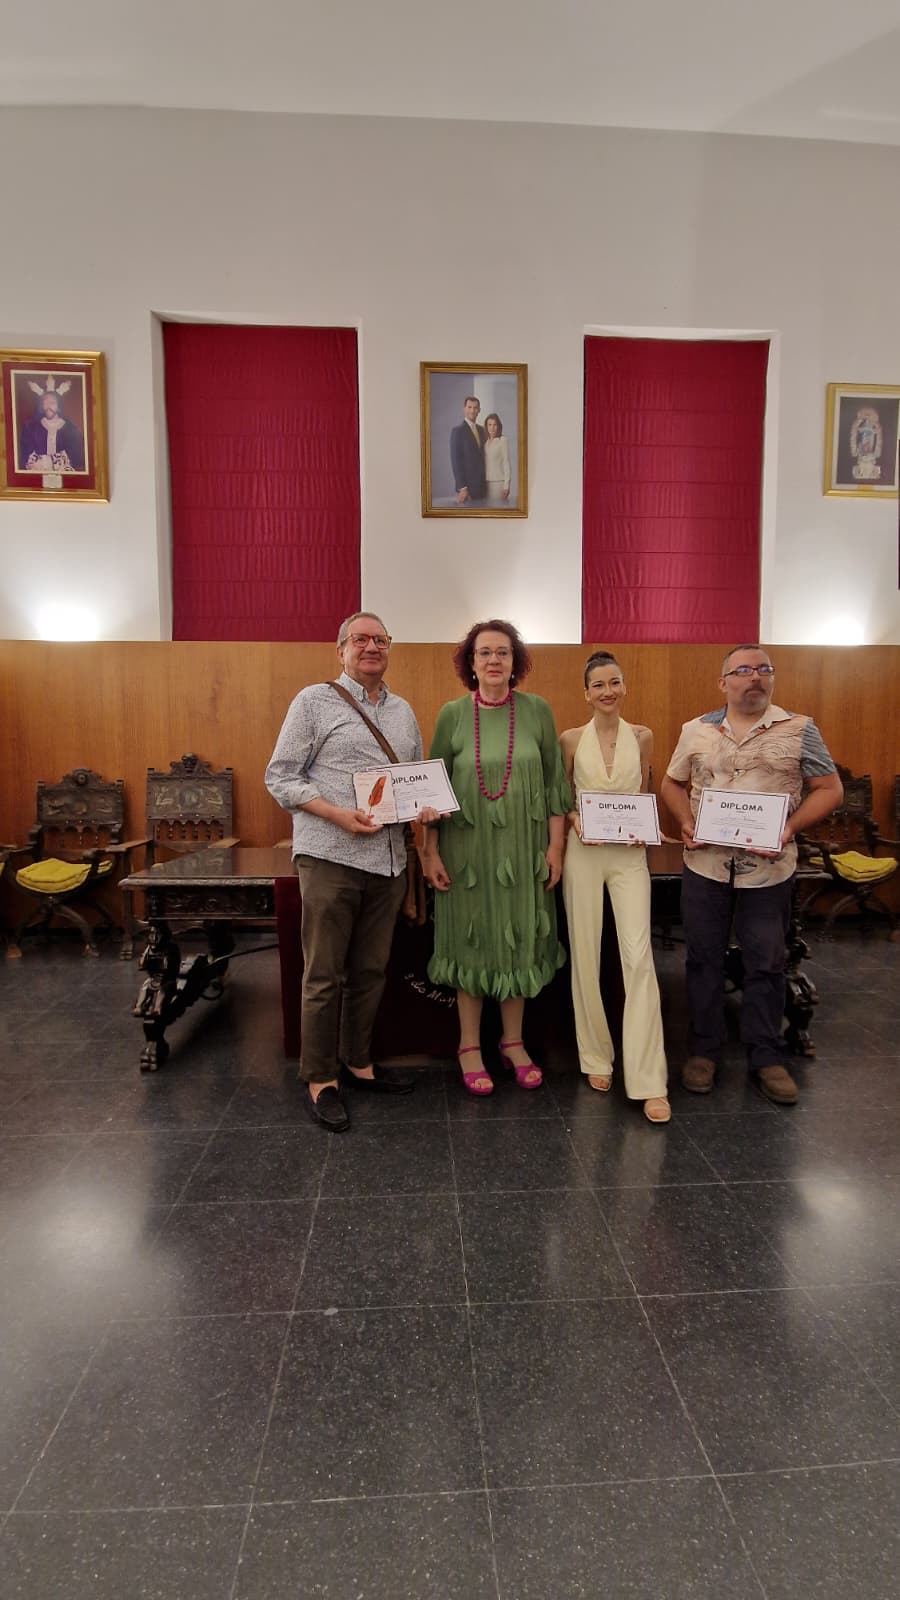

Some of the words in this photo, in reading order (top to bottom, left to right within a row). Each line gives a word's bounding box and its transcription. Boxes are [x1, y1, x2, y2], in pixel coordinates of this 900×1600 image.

[392, 774, 428, 784] DIPLOMA
[599, 802, 637, 810] DIPLOMA
[720, 801, 763, 811] DIPLOMA
